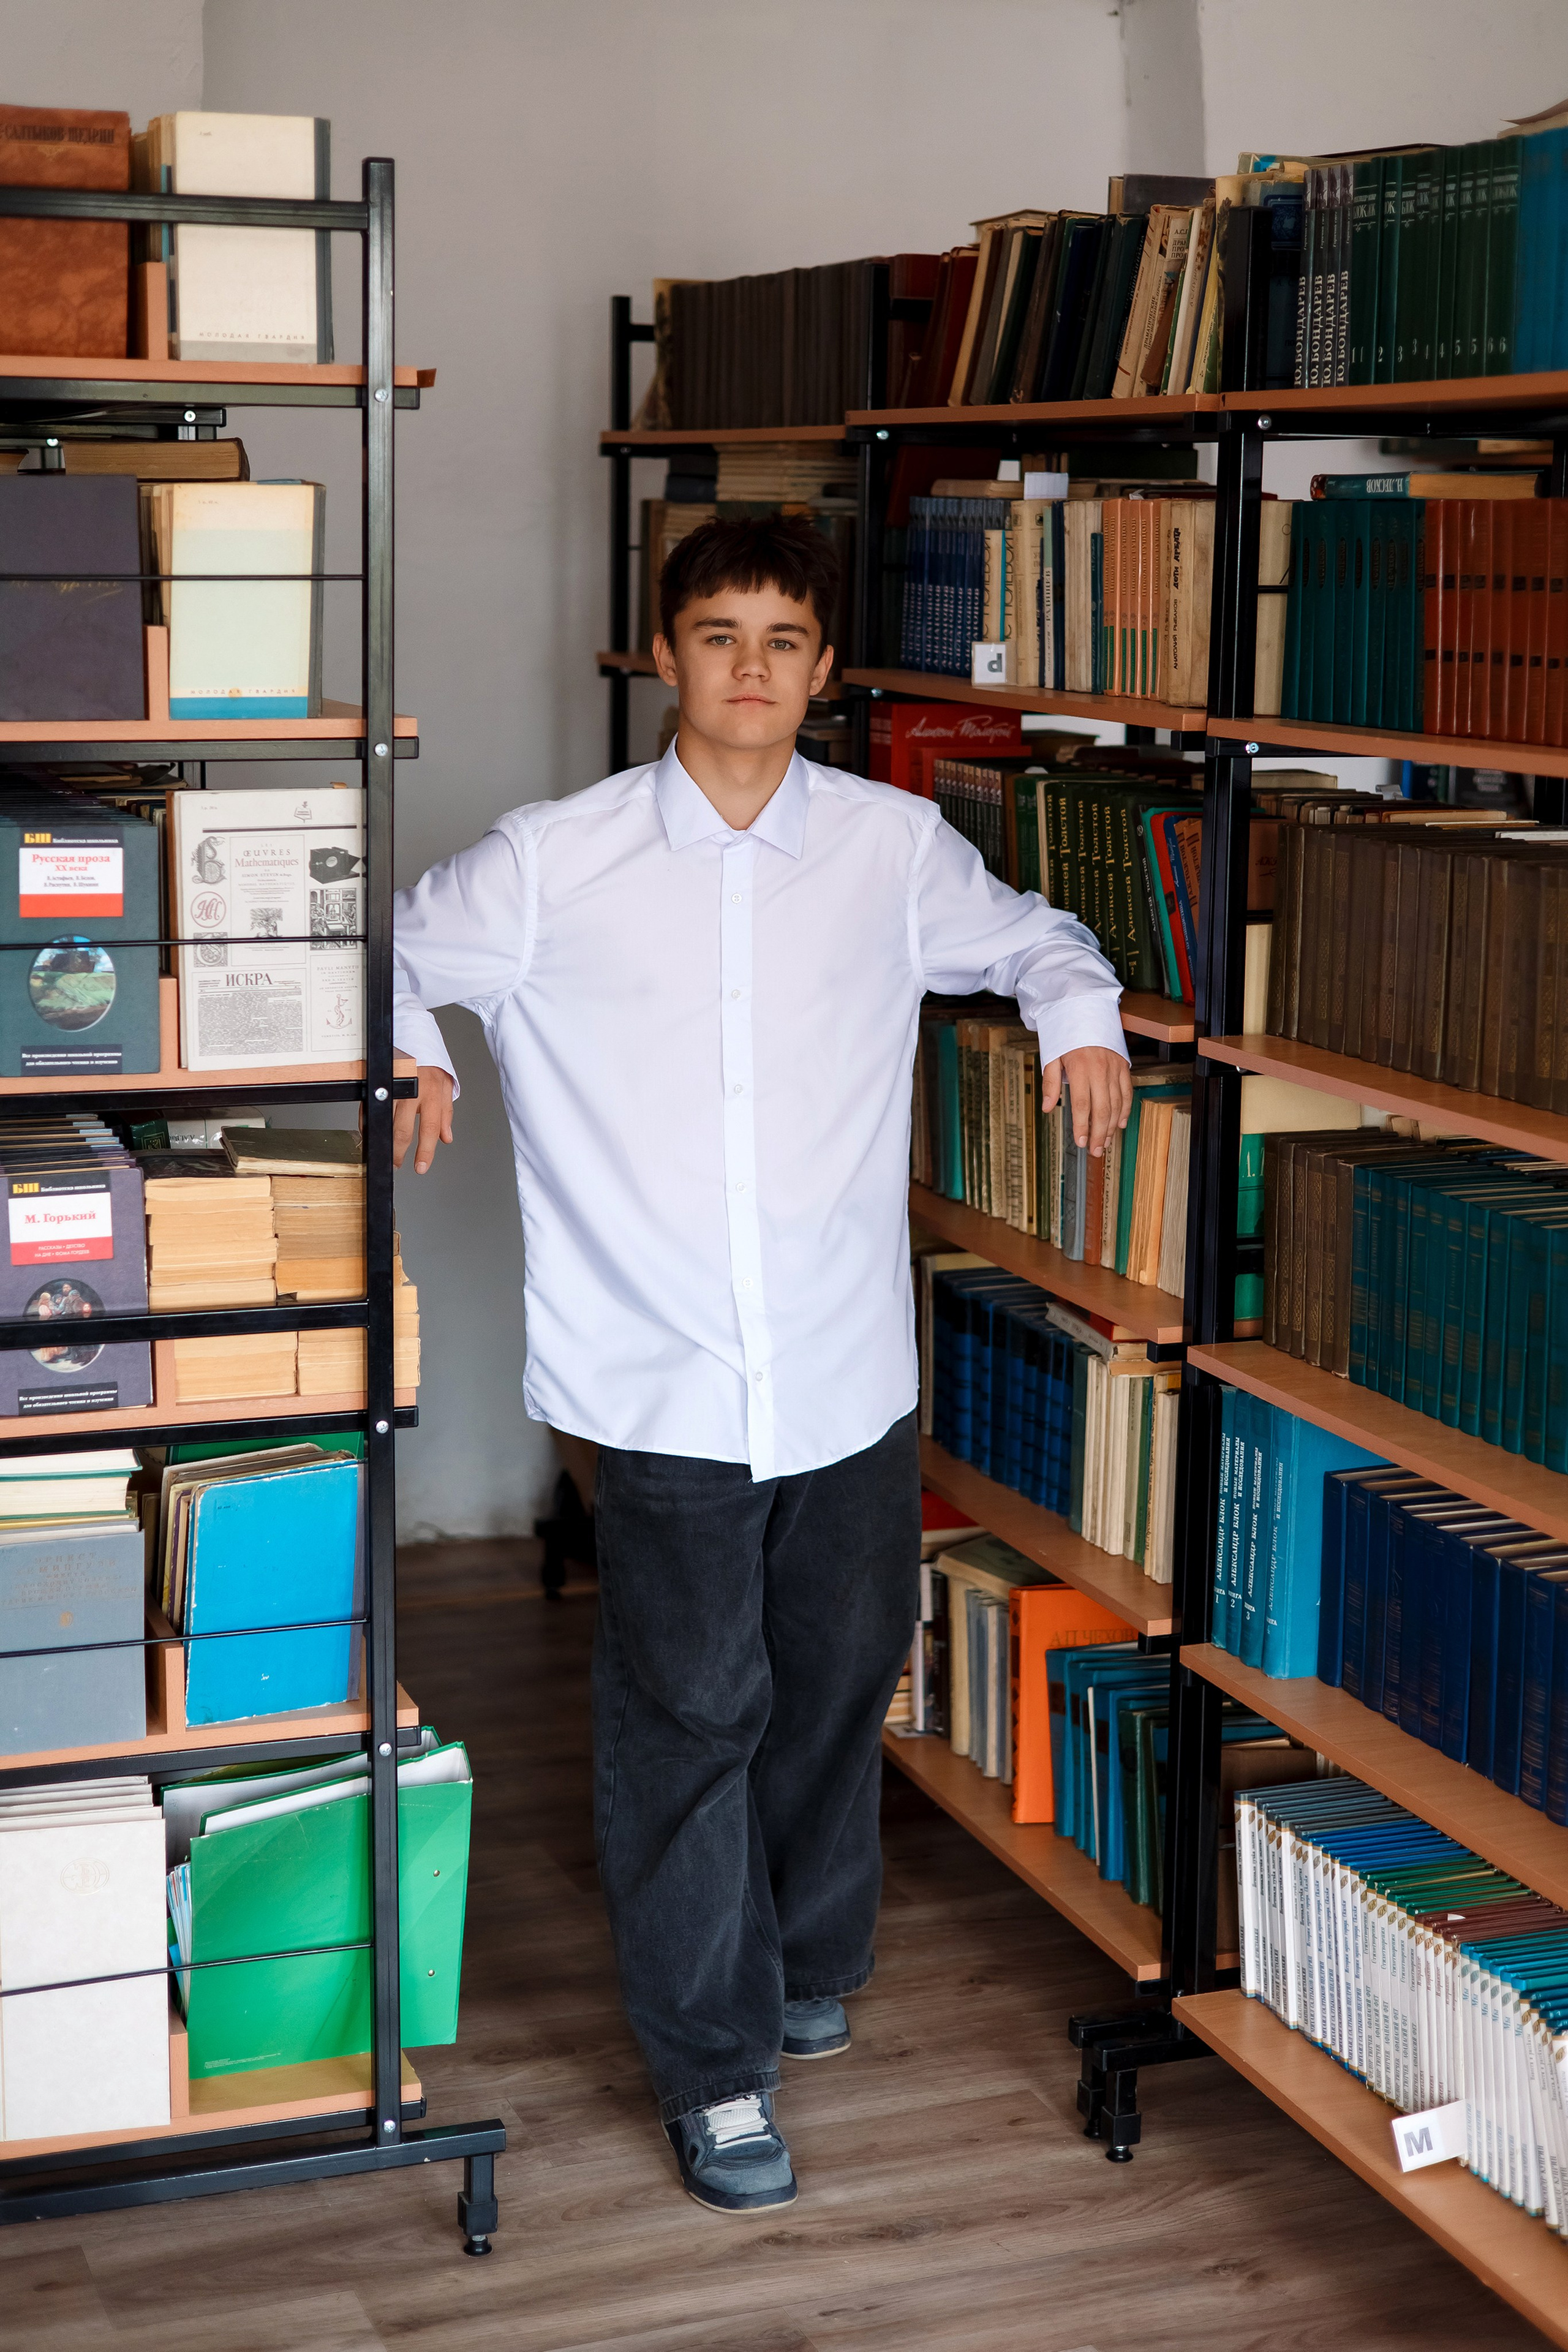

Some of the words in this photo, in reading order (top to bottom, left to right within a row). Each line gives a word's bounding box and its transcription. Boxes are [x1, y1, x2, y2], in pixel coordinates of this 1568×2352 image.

[1295, 276, 1306, 363] БОНДАРЕВ
[1311, 276, 1324, 362] БОНДАРЕВ
[1323, 274, 1336, 361] БОНДАРЕВ
[1338, 271, 1349, 359] БОНДАРЕВ
[1378, 346, 1383, 363] 2
[1398, 345, 1403, 363] 3
[1455, 339, 1461, 355] 5
[1471, 338, 1477, 355] 5
[1487, 337, 1493, 353] 6
[1499, 336, 1506, 353] 6
[1294, 366, 1302, 385] Ю.
[1310, 365, 1319, 385] Ю.
[1323, 364, 1332, 385] Ю.
[1336, 362, 1344, 382] Ю.
[1058, 797, 1070, 858] Толстой
[1077, 800, 1087, 861] Толстой
[1091, 803, 1101, 865] Толстой
[1104, 805, 1115, 869] Толстой
[24, 833, 51, 844] БШ
[1120, 808, 1132, 871] Толстой
[32, 854, 75, 865] Русская
[78, 856, 110, 864] проза
[235, 858, 300, 869] Mathematiques
[1093, 870, 1102, 935] Алексей
[1107, 873, 1116, 938] Алексей
[1125, 875, 1137, 941] Алексей
[225, 973, 273, 987] ИСКРА
[12, 1183, 40, 1194] БШ
[24, 1214, 40, 1224] М.
[43, 1210, 97, 1224] Горький
[1216, 1526, 1225, 1581] АЛЕКСАНДР
[1231, 1531, 1239, 1586] АЛЕКСАНДР
[1268, 1554, 1276, 1611] АЛЕКСАНДР
[1463, 1988, 1469, 2001] Мы
[1471, 1994, 1479, 2008] Мы
[1481, 2003, 1488, 2017] Мы
[1403, 2127, 1433, 2157] М
[1537, 2145, 1546, 2174] КУПРИН
